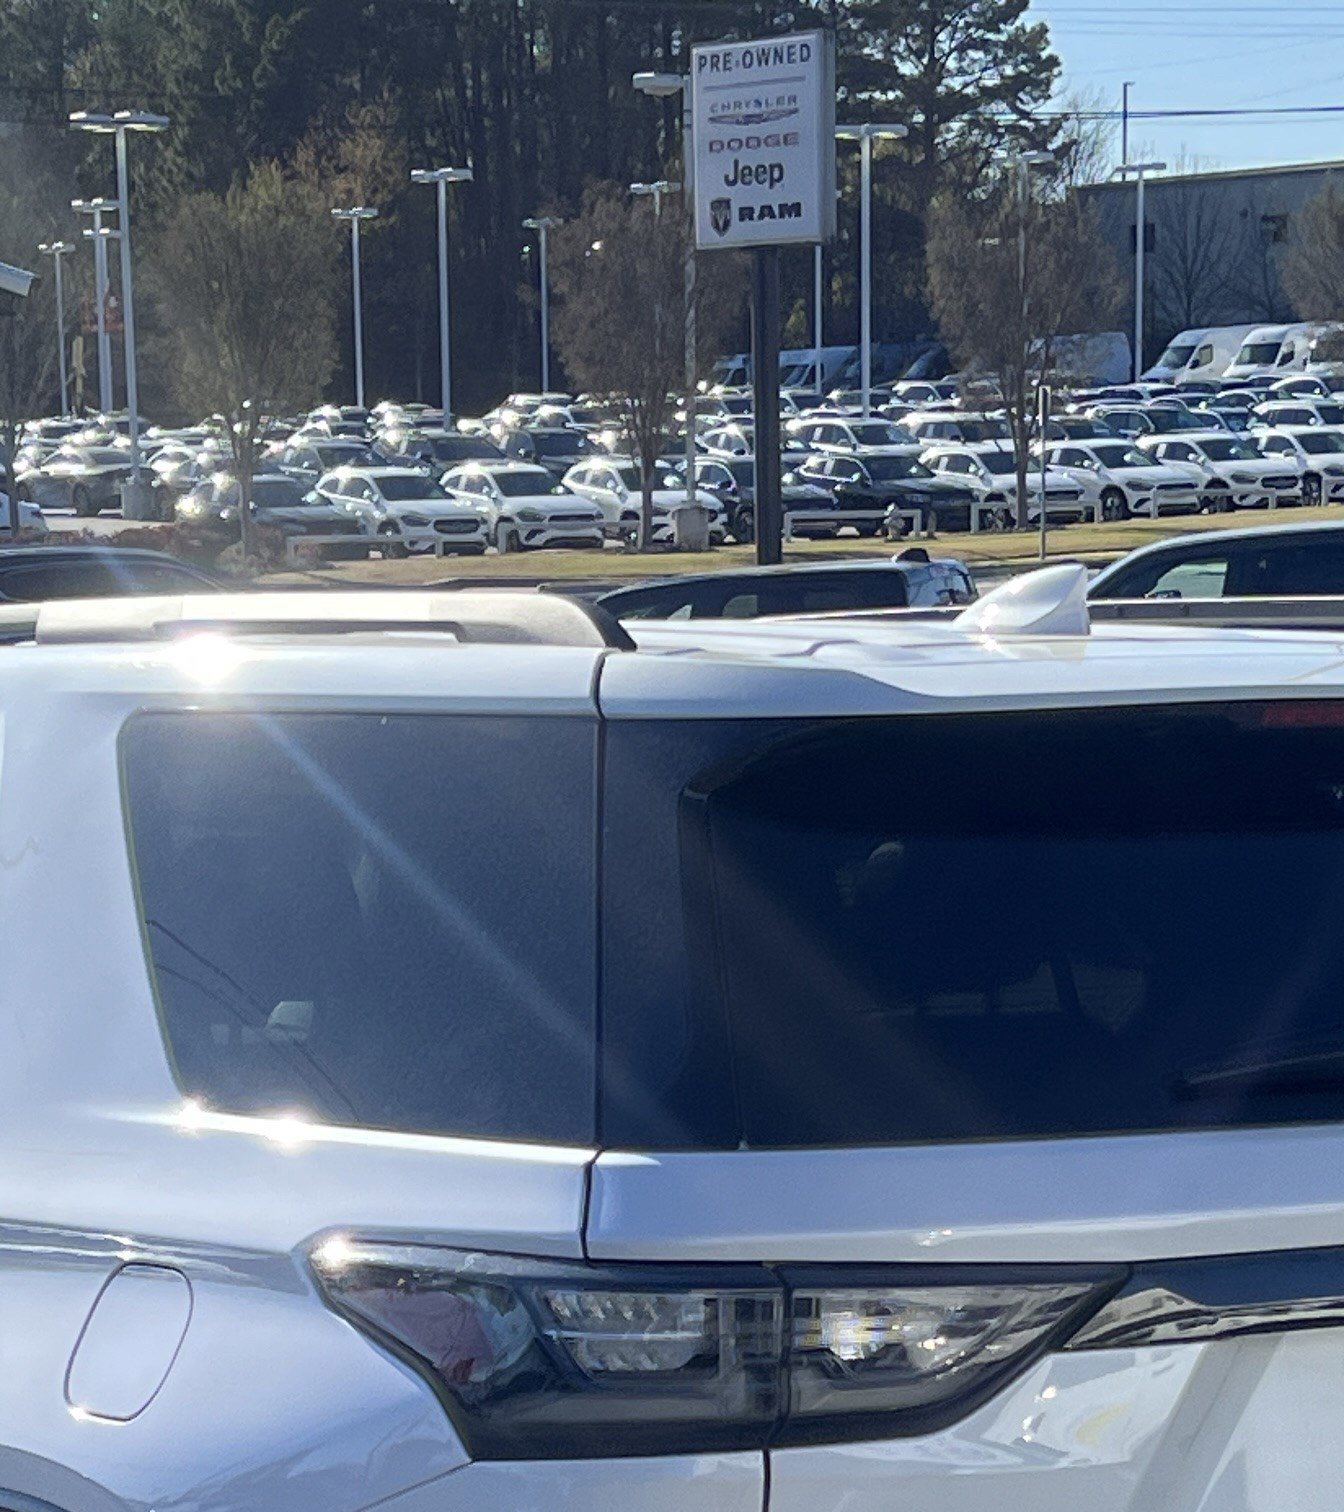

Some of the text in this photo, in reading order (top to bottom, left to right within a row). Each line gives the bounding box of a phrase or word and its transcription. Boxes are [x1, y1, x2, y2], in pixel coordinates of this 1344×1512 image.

[710, 95, 798, 113] CHRYSLER
[709, 132, 800, 153] DODGE
[724, 158, 784, 189] Jeep
[738, 202, 802, 222] RAM
